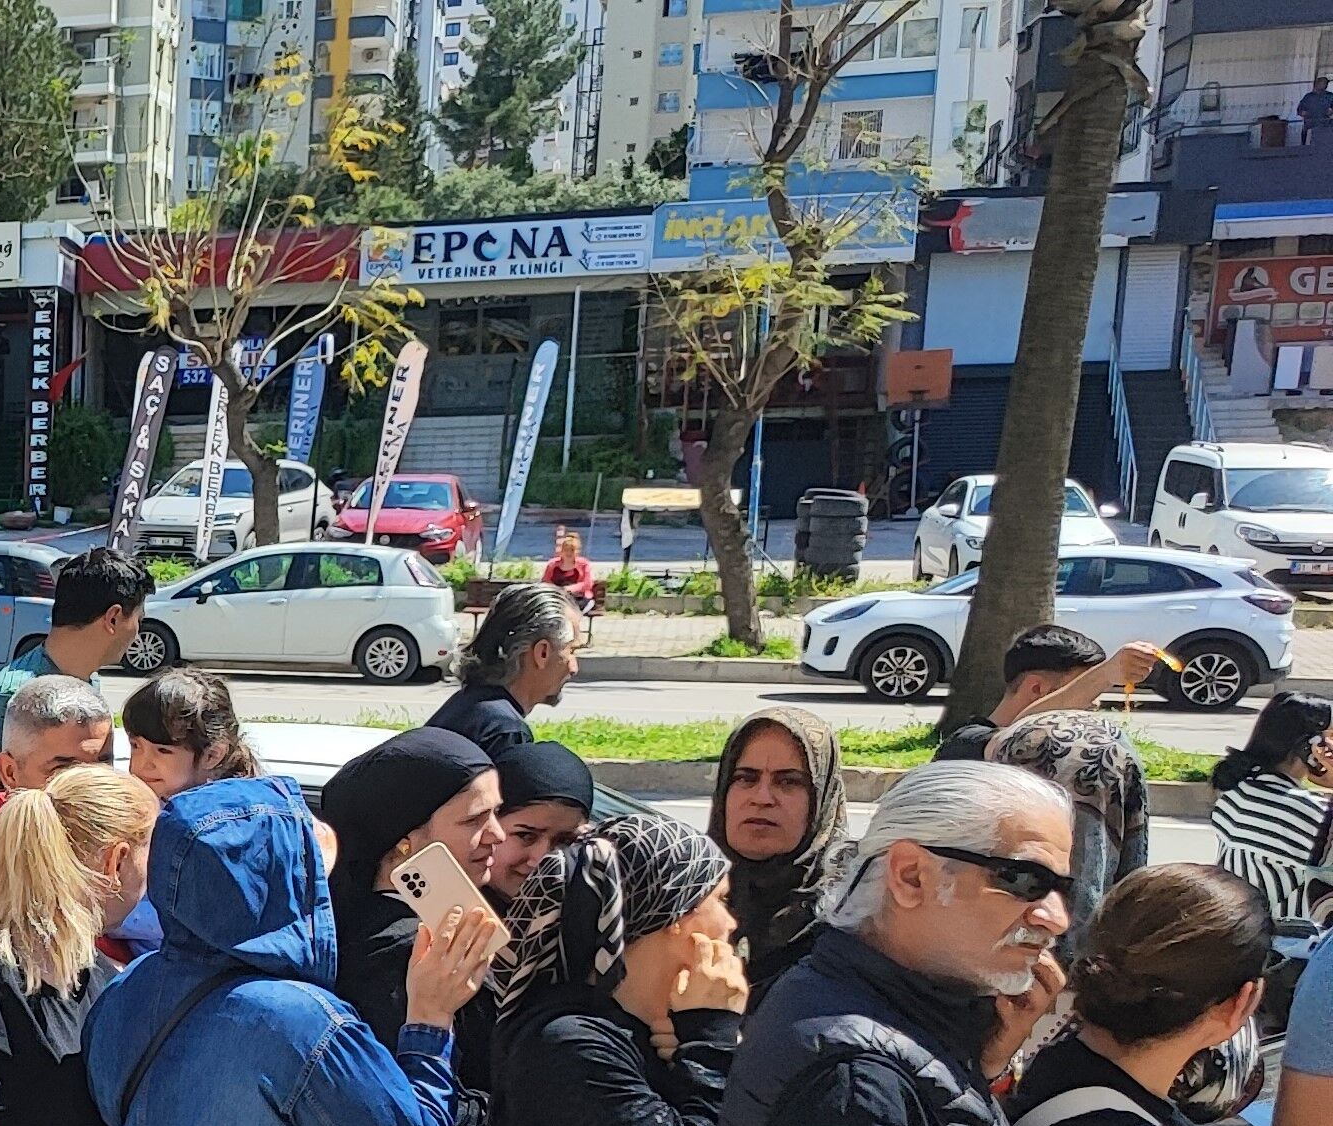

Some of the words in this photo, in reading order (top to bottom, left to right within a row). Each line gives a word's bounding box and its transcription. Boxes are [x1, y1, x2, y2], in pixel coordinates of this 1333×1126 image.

[411, 226, 573, 264] EPONA
[31, 309, 52, 391] ERKEK
[147, 355, 171, 416] SAÇ
[182, 369, 207, 384] 532
